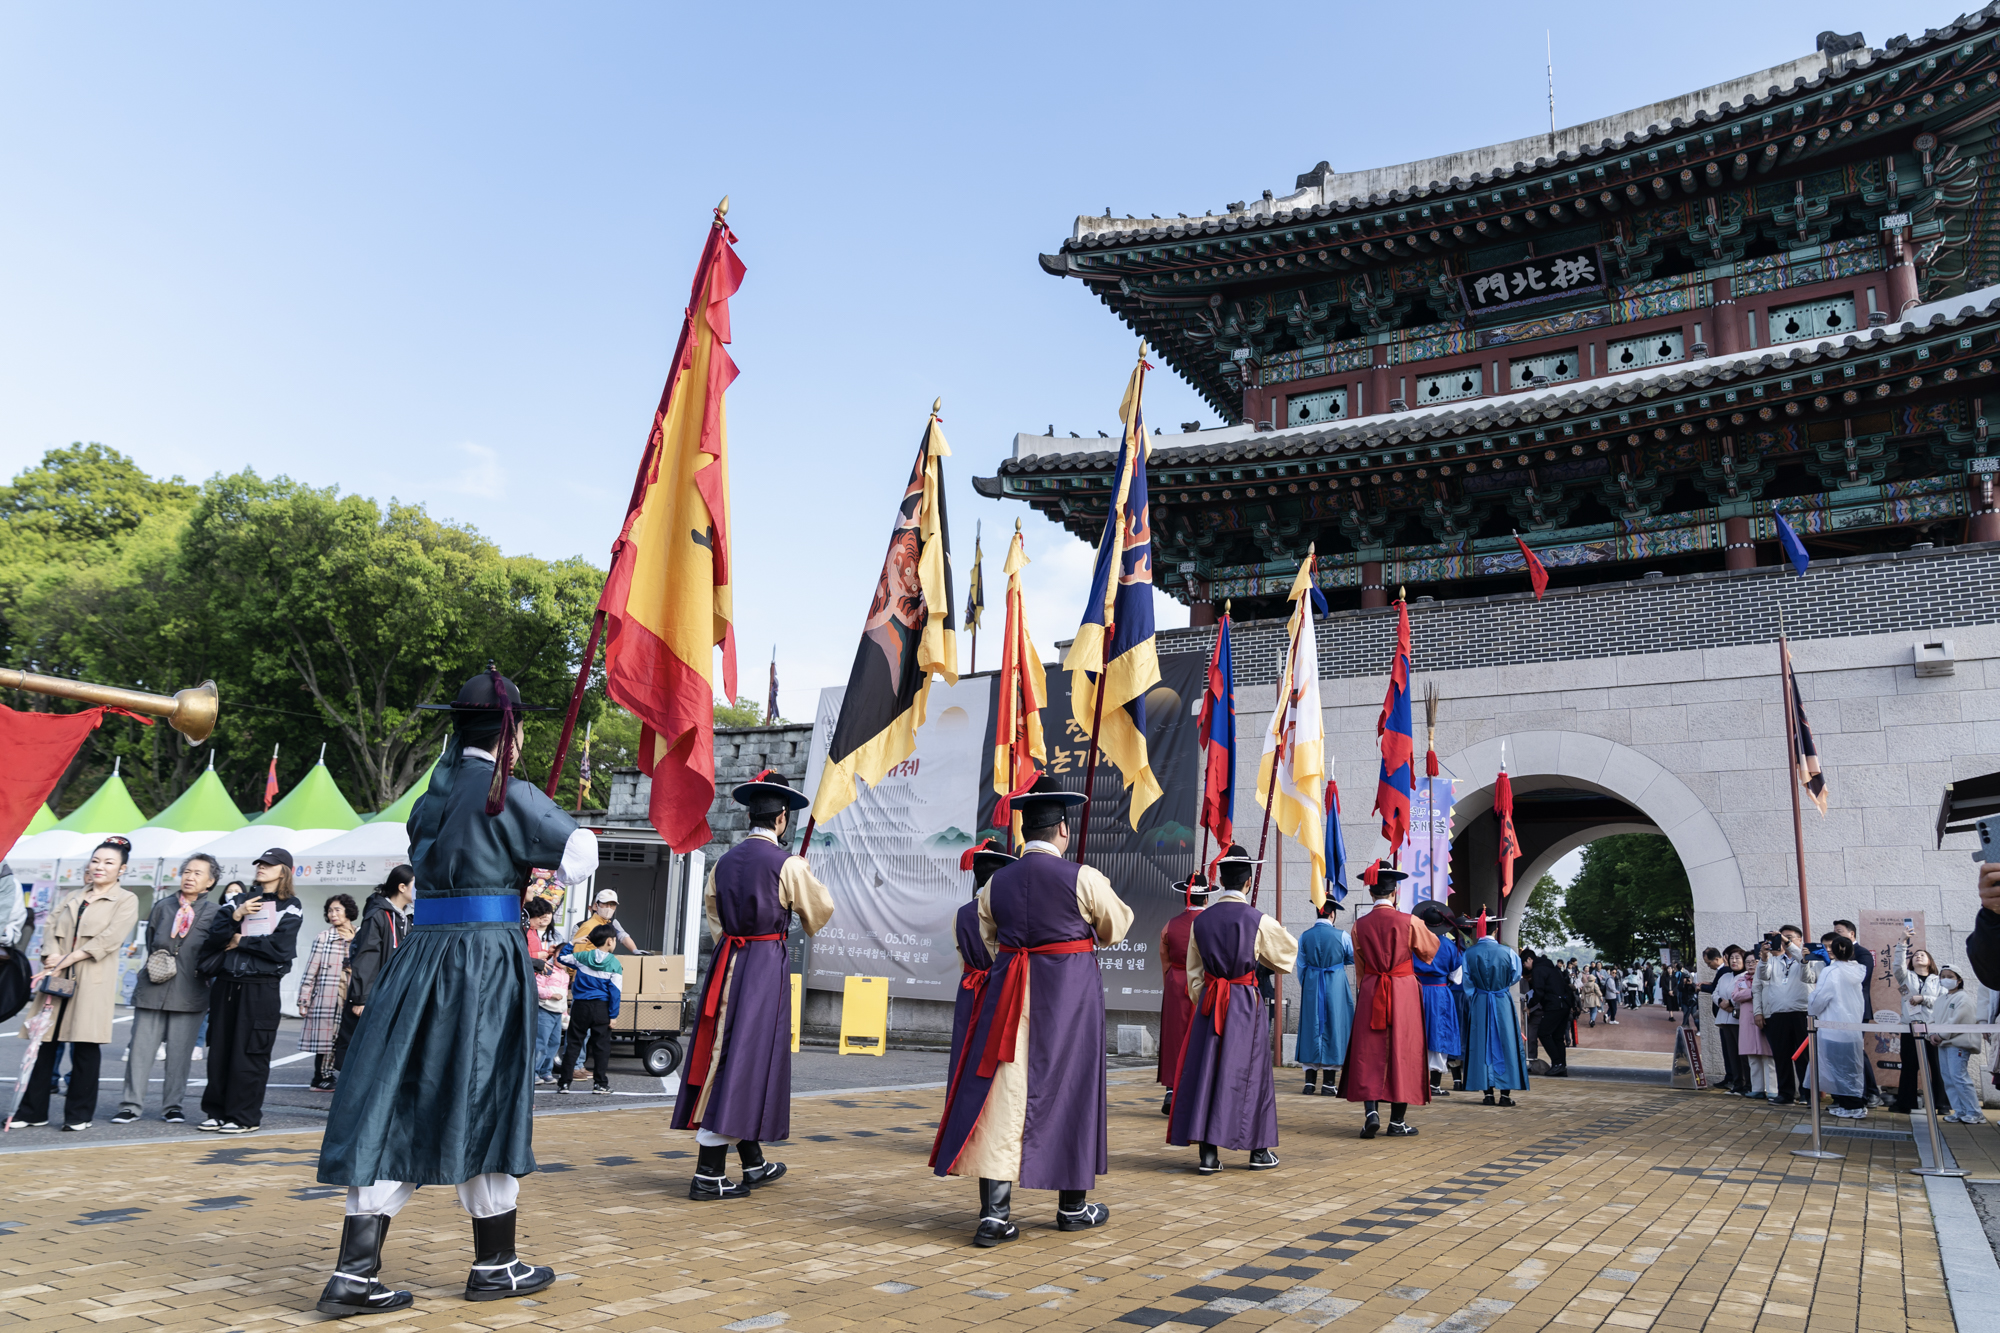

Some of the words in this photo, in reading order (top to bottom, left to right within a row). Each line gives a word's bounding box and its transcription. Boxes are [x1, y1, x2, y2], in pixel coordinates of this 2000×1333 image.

[314, 860, 367, 875] 종합안내소
[885, 932, 919, 946] 05.06.
[812, 943, 836, 955] 진주성
[838, 945, 845, 956] 및
[913, 952, 929, 963] 일원
[1133, 942, 1148, 953] (화)
[1126, 958, 1145, 970] 일원
